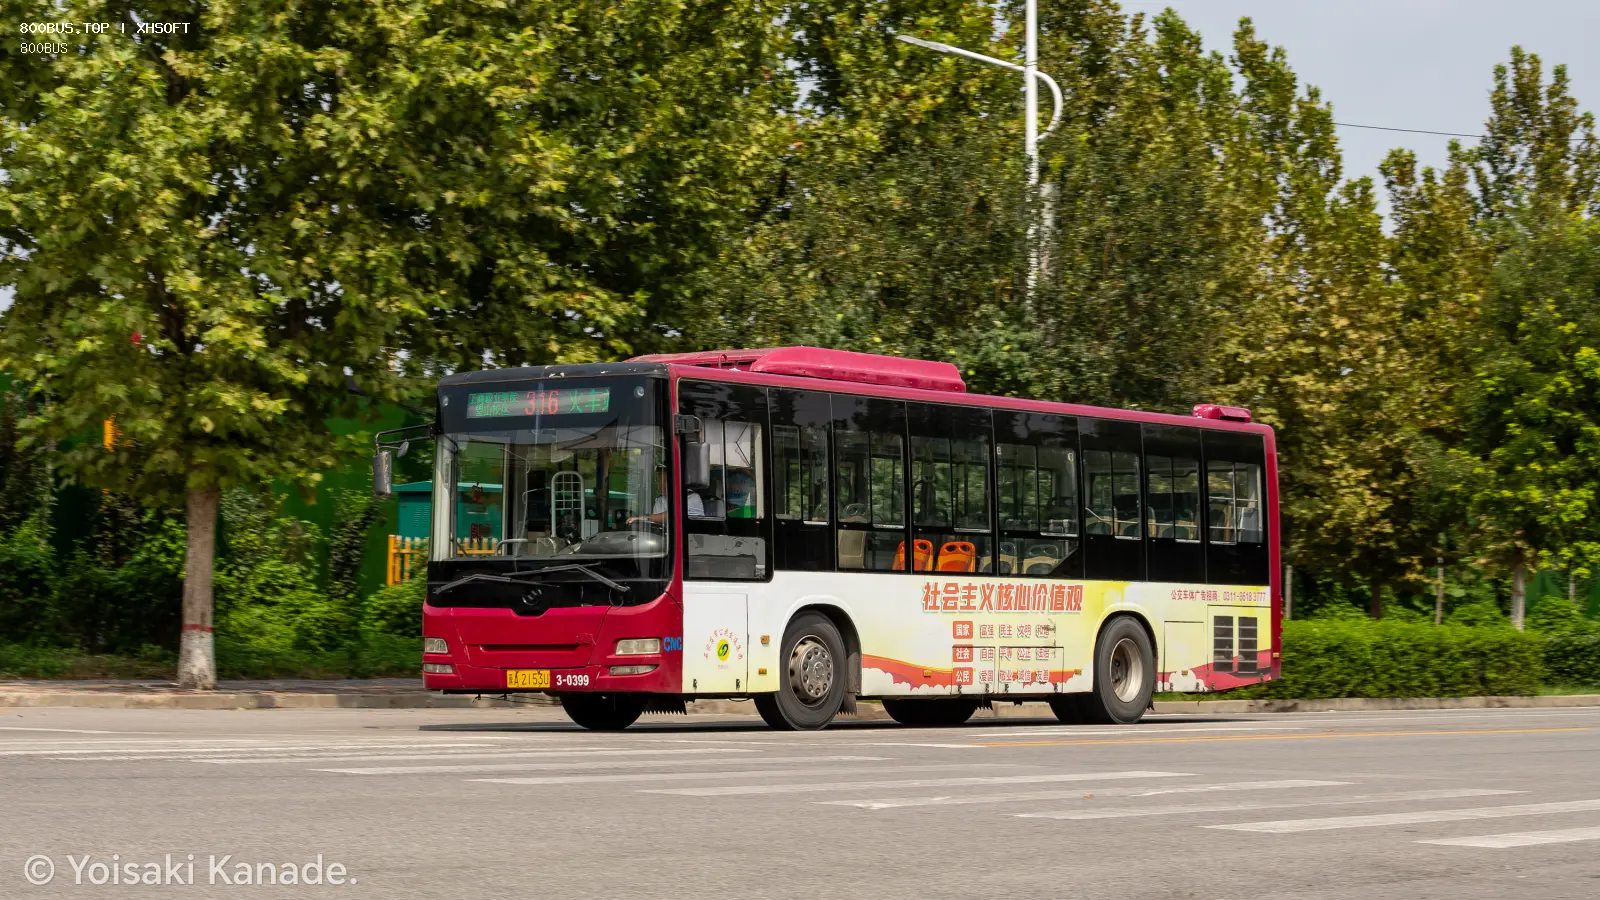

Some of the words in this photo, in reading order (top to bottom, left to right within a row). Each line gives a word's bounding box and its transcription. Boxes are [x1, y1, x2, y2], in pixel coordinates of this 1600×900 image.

[525, 390, 559, 416] 316
[922, 582, 1084, 612] 社会主义核心价值观
[956, 624, 970, 636] 国家
[981, 624, 994, 636] 富强
[1000, 624, 1013, 636] 民主
[1018, 624, 1031, 636] 文明
[956, 648, 970, 659] 社会
[981, 647, 994, 659] 自由
[1018, 647, 1031, 659] 公正
[556, 674, 590, 687] 3-0399
[956, 670, 970, 683] 公民
[980, 669, 994, 682] 爱国
[1018, 669, 1032, 682] 诚信
[1037, 669, 1050, 681] 友善
